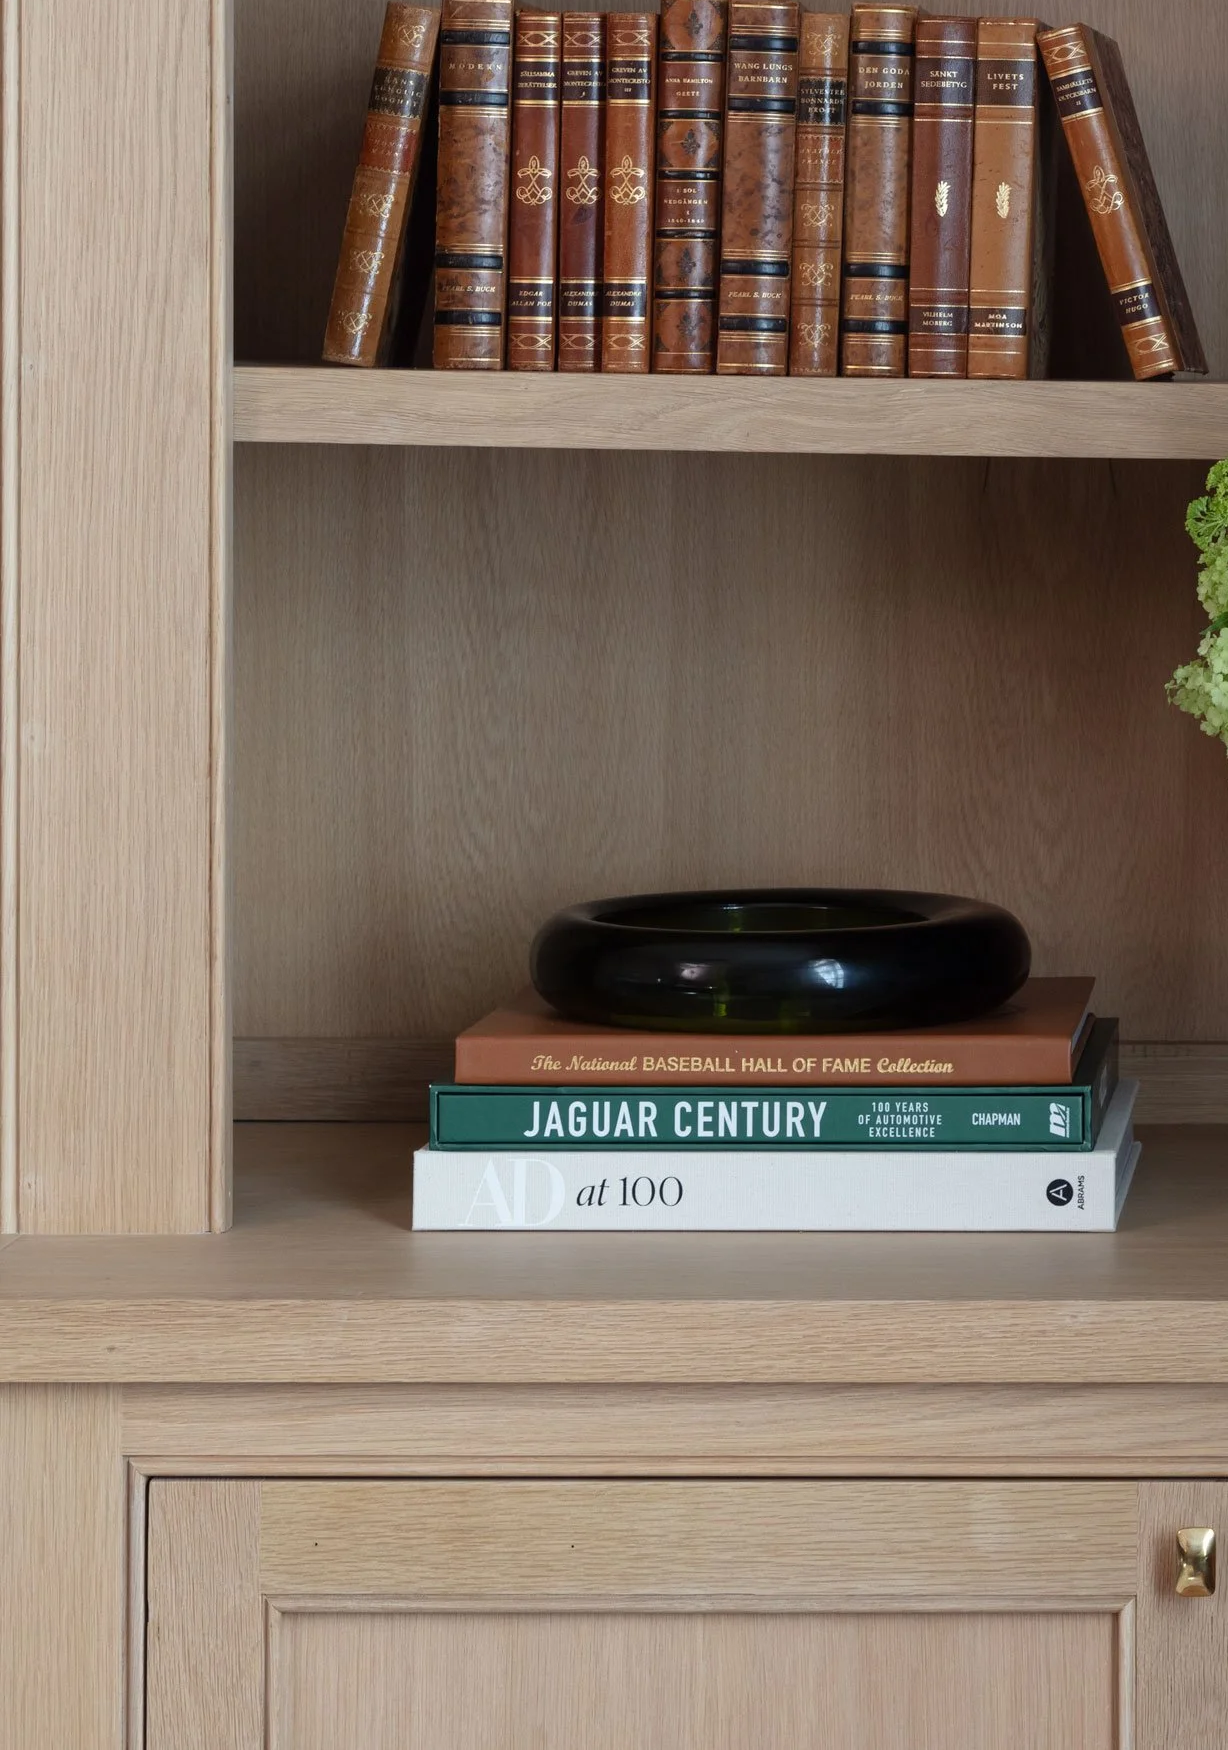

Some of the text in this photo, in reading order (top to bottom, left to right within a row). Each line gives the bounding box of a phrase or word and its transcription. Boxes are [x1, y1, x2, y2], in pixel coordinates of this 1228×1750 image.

[449, 63, 503, 71] MODERN
[734, 62, 793, 71] WANG LUNGS
[882, 67, 910, 75] GODA
[738, 76, 787, 84] BARNBARN
[987, 73, 1024, 81] LIVETS
[864, 81, 903, 89] JORDEN
[921, 81, 968, 89] SEDEBETYG
[1118, 292, 1150, 306] VICTOR
[1124, 303, 1149, 314] HUGO
[974, 321, 1023, 329] MARTINSON
[530, 1054, 954, 1074] The National BASEBALL HALL OF FAME Collection
[871, 1102, 929, 1113] 100 YEARS
[523, 1101, 827, 1138] JAGUAR CENTURY
[858, 1114, 942, 1125] OF AUTOMOTIVE
[971, 1113, 1021, 1126] CHAPMAN
[869, 1127, 936, 1138] EXCELLENCE
[457, 1157, 566, 1227] AD
[576, 1176, 684, 1207] at 100
[1077, 1175, 1085, 1210] ABRAMS
